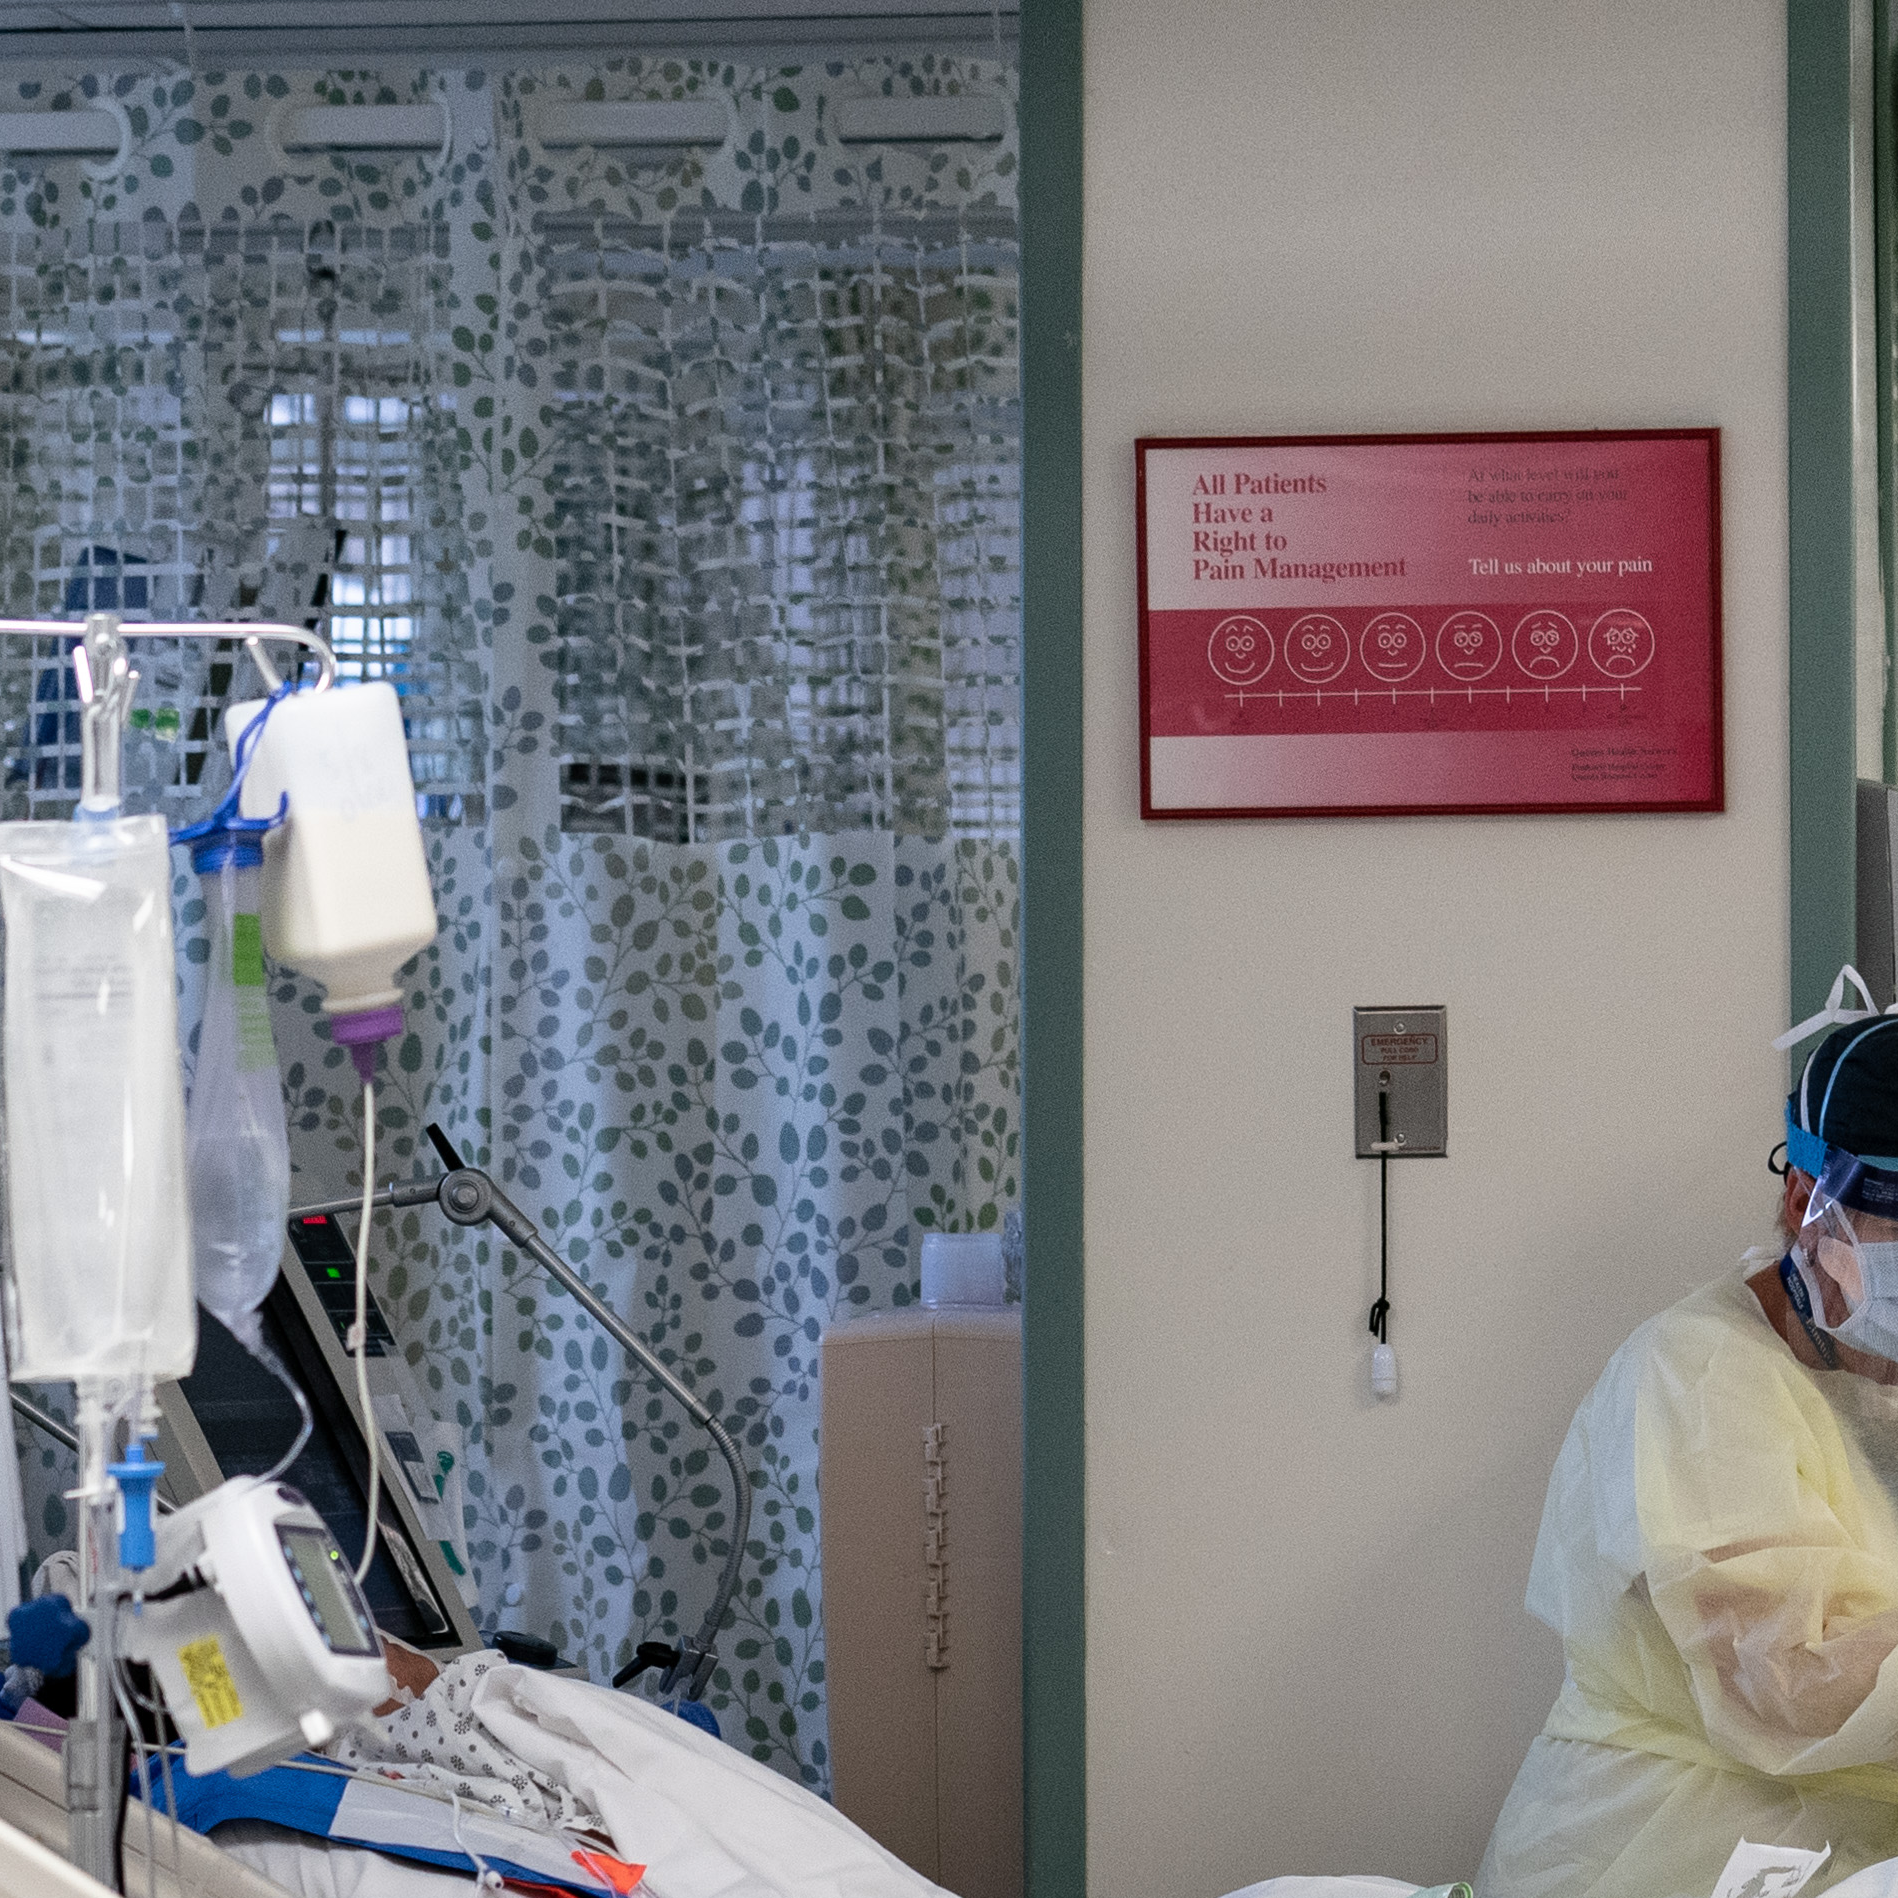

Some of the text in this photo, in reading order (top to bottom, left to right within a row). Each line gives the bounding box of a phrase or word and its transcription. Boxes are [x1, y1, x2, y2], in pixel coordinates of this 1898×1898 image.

[1192, 472, 1328, 496] All Patients
[1192, 502, 1274, 524] Have a
[1192, 530, 1288, 558] Right to
[1193, 556, 1407, 584] Pain Management
[1468, 555, 1653, 578] Tell us about your pain
[1371, 1037, 1428, 1046] EMERGENCY
